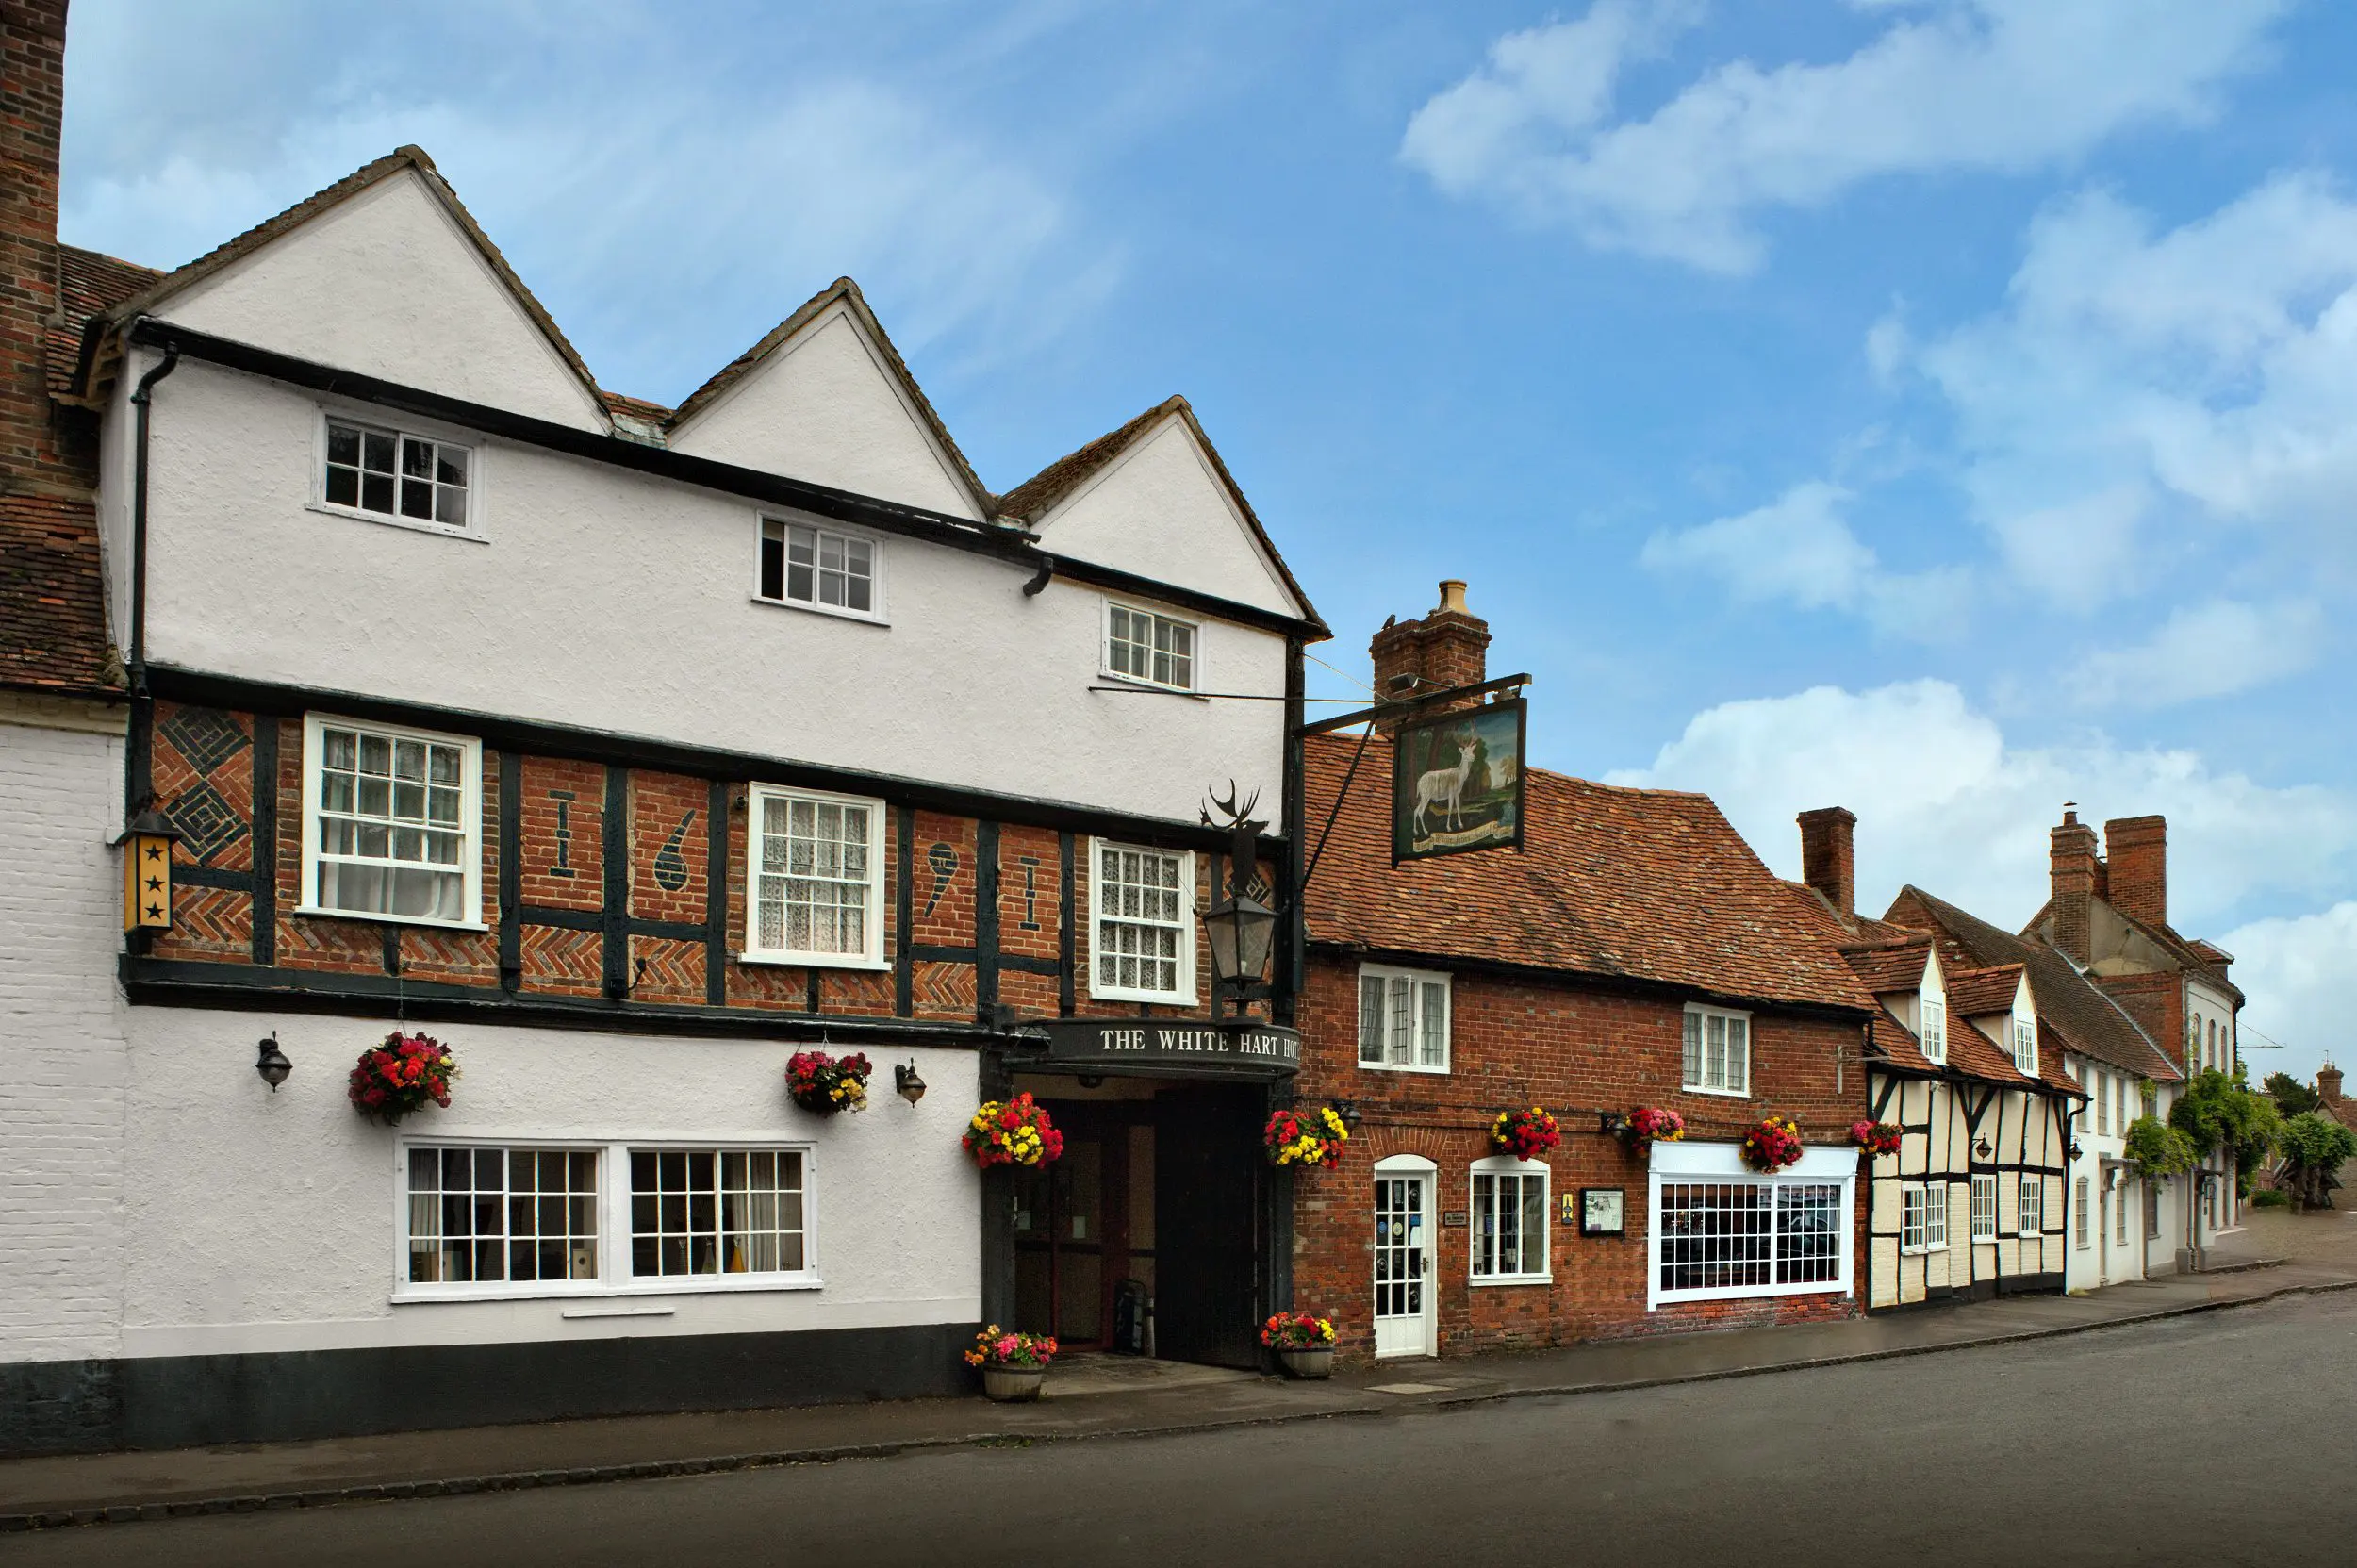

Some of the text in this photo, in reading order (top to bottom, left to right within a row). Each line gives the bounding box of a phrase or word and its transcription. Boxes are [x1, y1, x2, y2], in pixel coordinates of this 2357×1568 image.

[1099, 1030, 1146, 1049] THE
[1157, 1030, 1229, 1052] WHITE
[1239, 1033, 1278, 1055] HART
